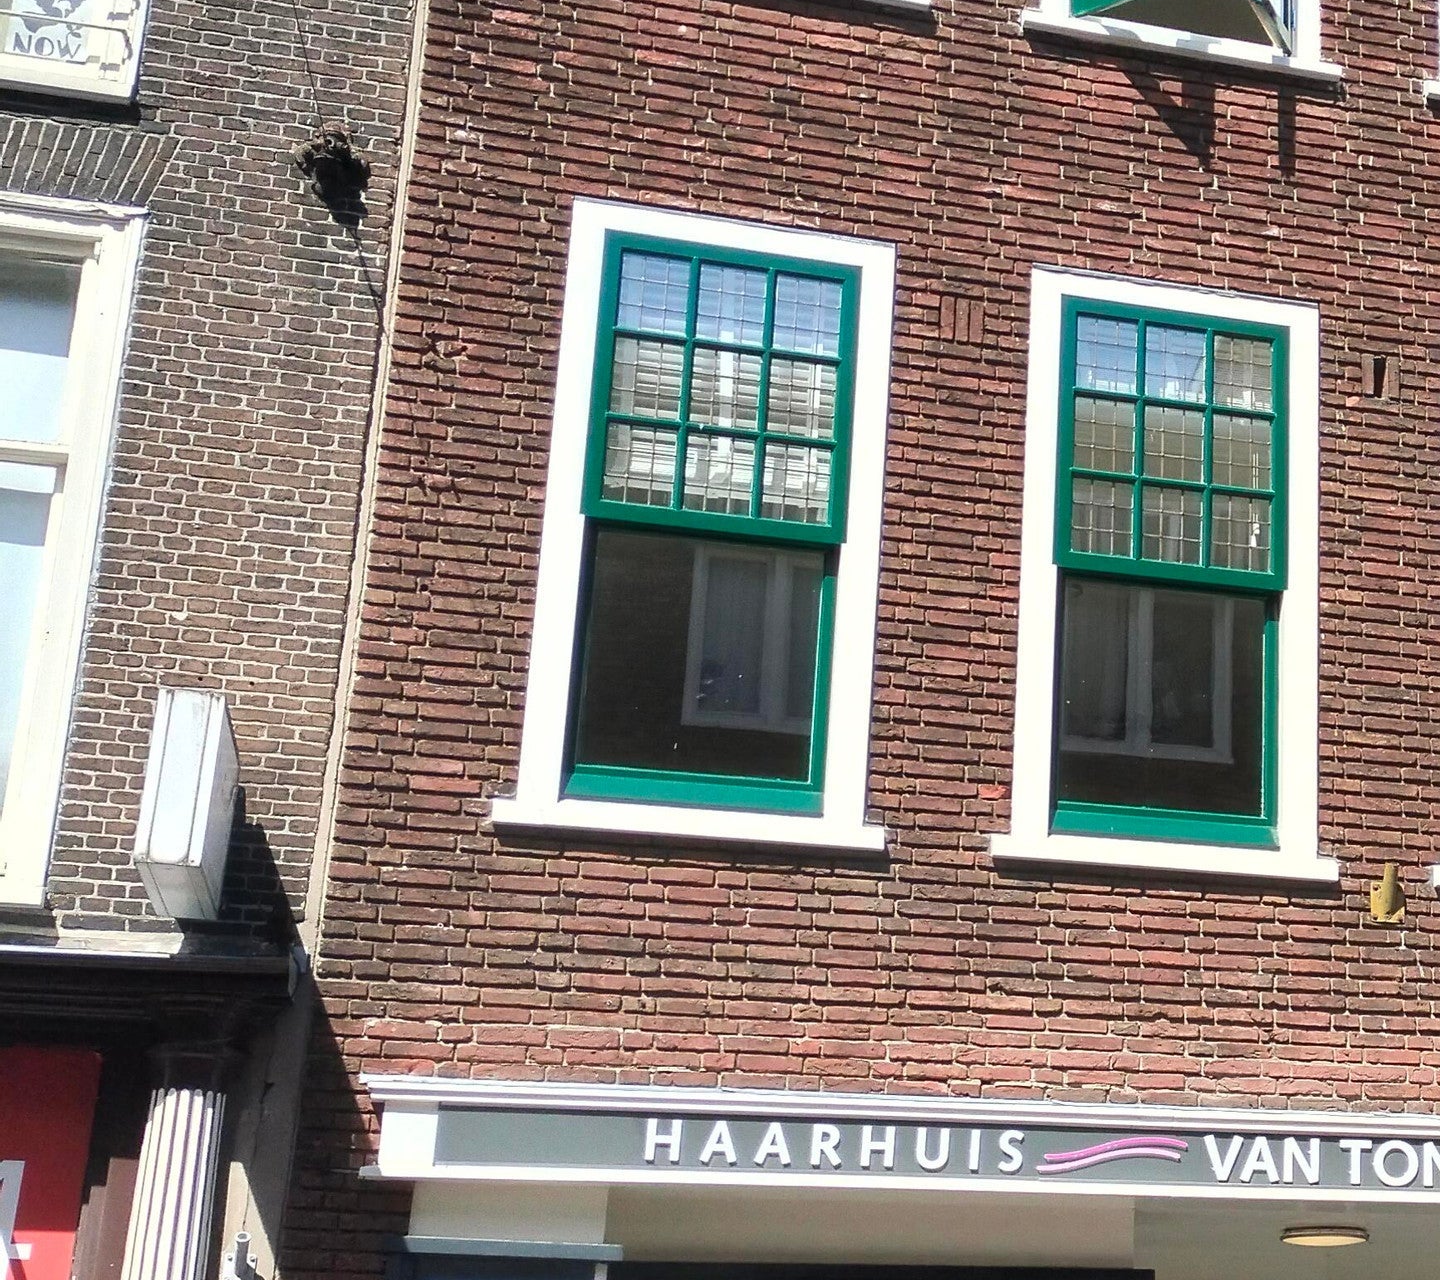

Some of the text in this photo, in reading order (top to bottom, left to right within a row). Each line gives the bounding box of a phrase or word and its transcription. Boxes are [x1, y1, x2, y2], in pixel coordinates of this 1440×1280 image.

[13, 32, 81, 59] NOW
[644, 1117, 1026, 1174] HAARHUIS
[1203, 1133, 1321, 1185] VAN
